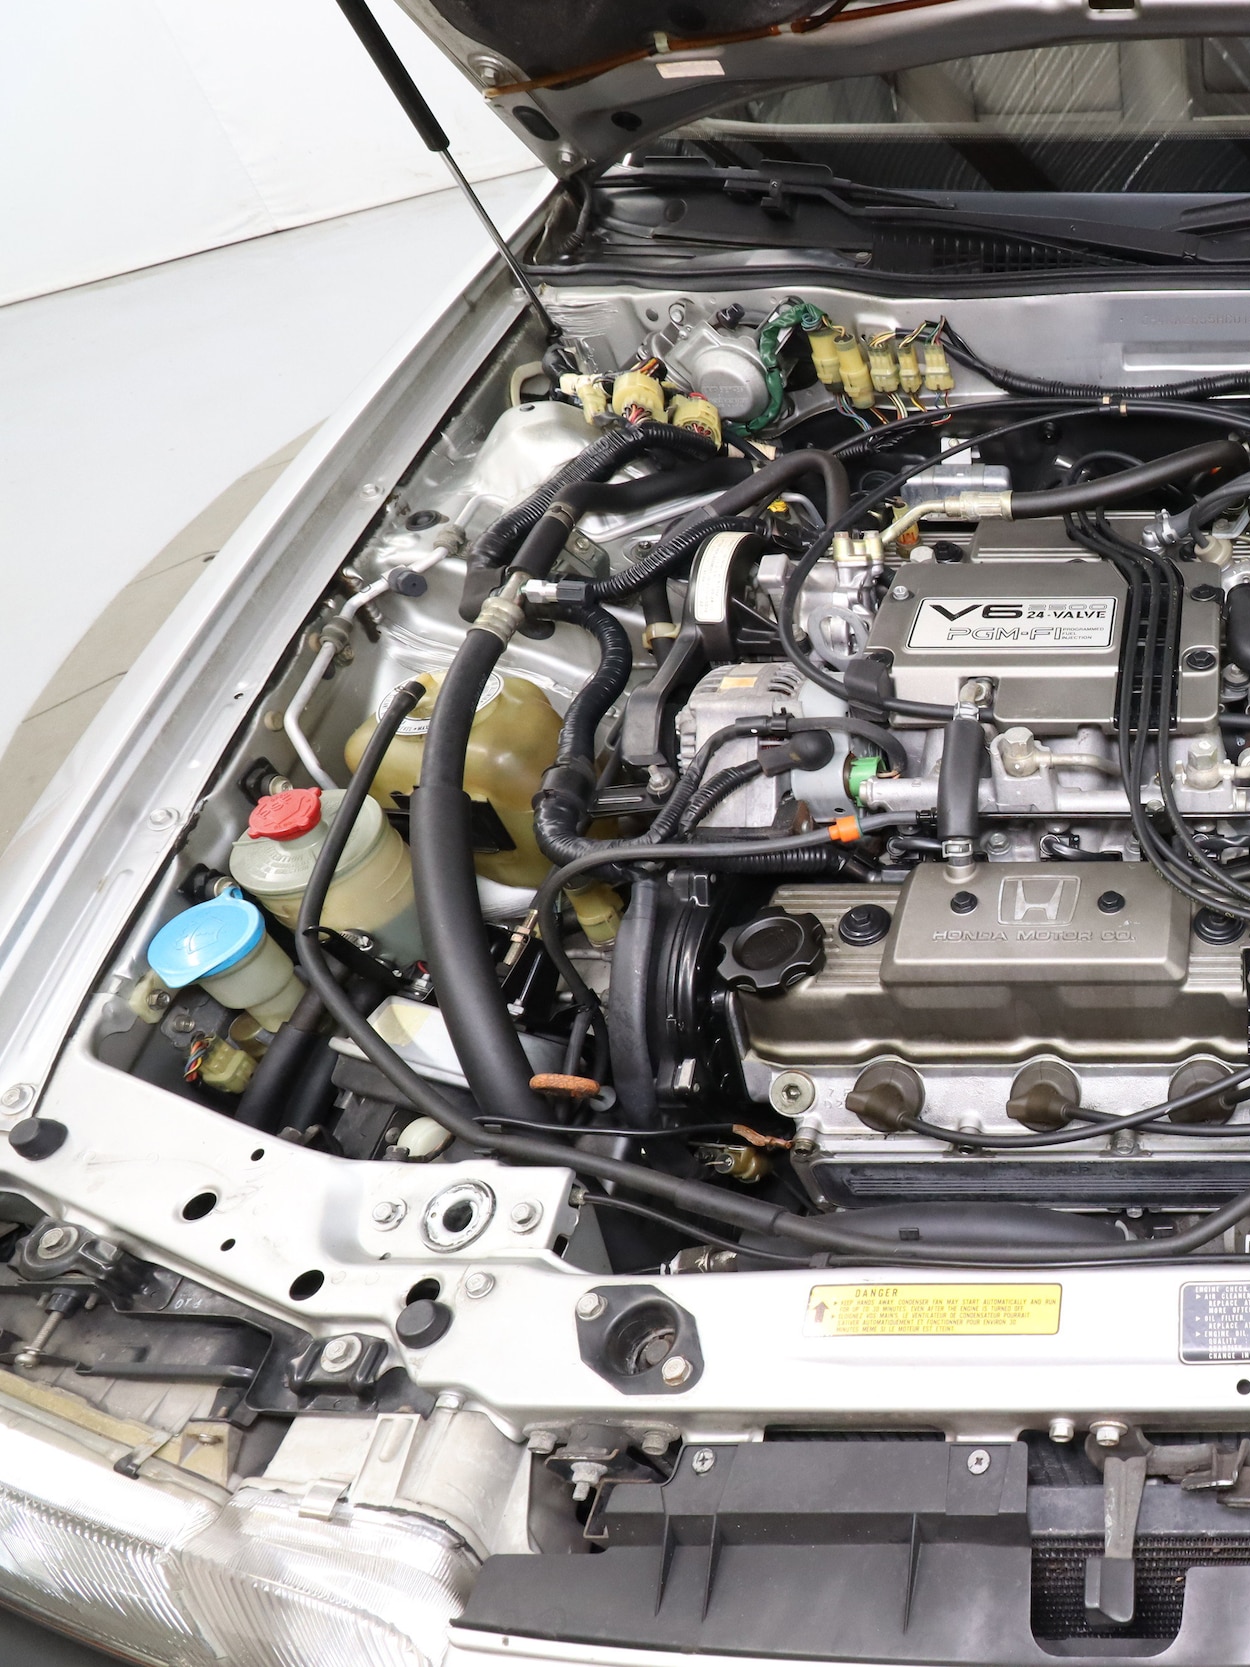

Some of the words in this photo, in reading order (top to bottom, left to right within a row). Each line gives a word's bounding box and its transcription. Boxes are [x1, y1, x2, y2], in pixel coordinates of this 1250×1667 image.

[929, 604, 1023, 622] V6
[947, 627, 1061, 641] PGM-FI
[932, 930, 1008, 943] HONDA
[1015, 930, 1093, 943] MOTOR
[1101, 930, 1136, 943] CO.
[855, 1288, 899, 1298] DANGER
[1221, 1314, 1246, 1322] FILTER.
[1208, 1322, 1238, 1330] REPLACE
[1208, 1337, 1237, 1345] QUALITY
[1208, 1352, 1235, 1360] CHANGE
